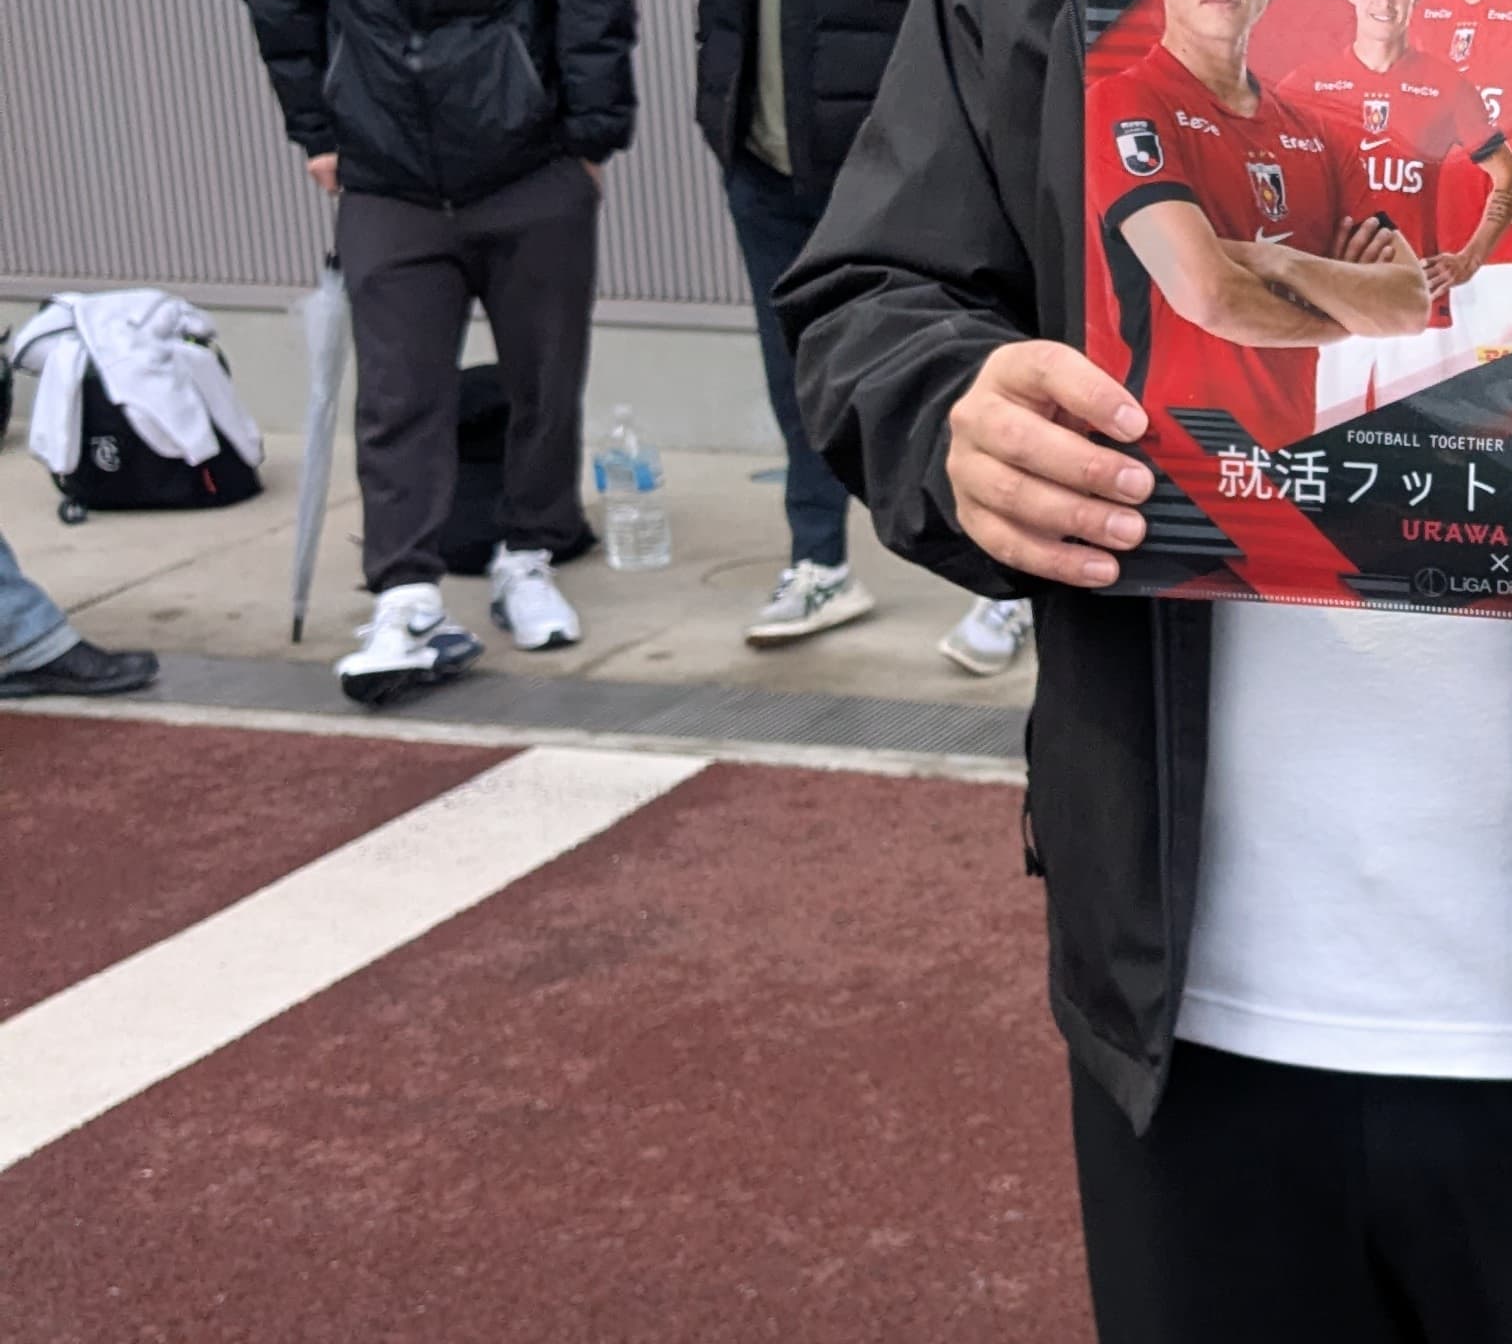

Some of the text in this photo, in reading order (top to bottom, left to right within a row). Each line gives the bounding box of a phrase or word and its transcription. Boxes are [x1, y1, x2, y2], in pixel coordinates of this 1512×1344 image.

[1359, 156, 1425, 194] LUS
[1347, 430, 1421, 448] FOOTBALL
[1430, 435, 1504, 453] TOGETHER
[1401, 519, 1509, 547] URAWA
